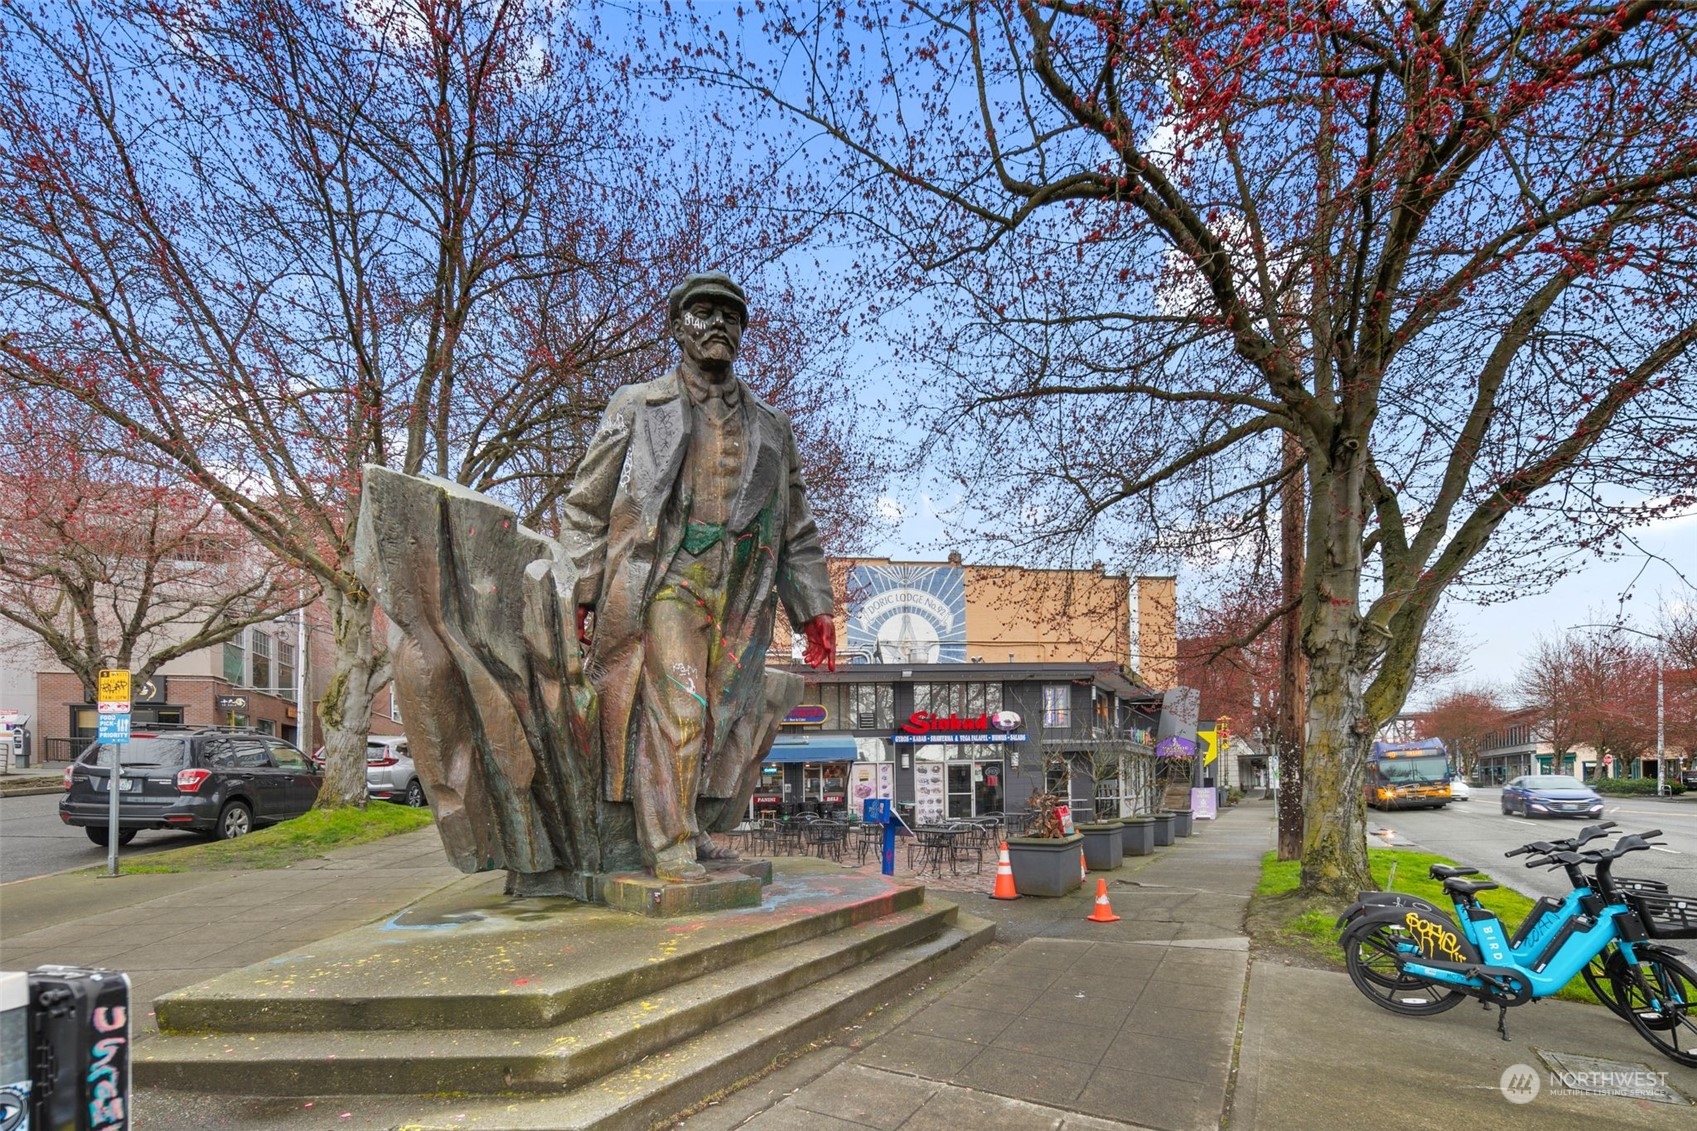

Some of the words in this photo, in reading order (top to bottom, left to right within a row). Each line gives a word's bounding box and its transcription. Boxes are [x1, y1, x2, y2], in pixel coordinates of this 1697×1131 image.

[867, 594, 895, 614] DORIC
[895, 593, 924, 604] LODGE
[902, 710, 987, 735] Sinbad
[1483, 925, 1503, 960] BIRD
